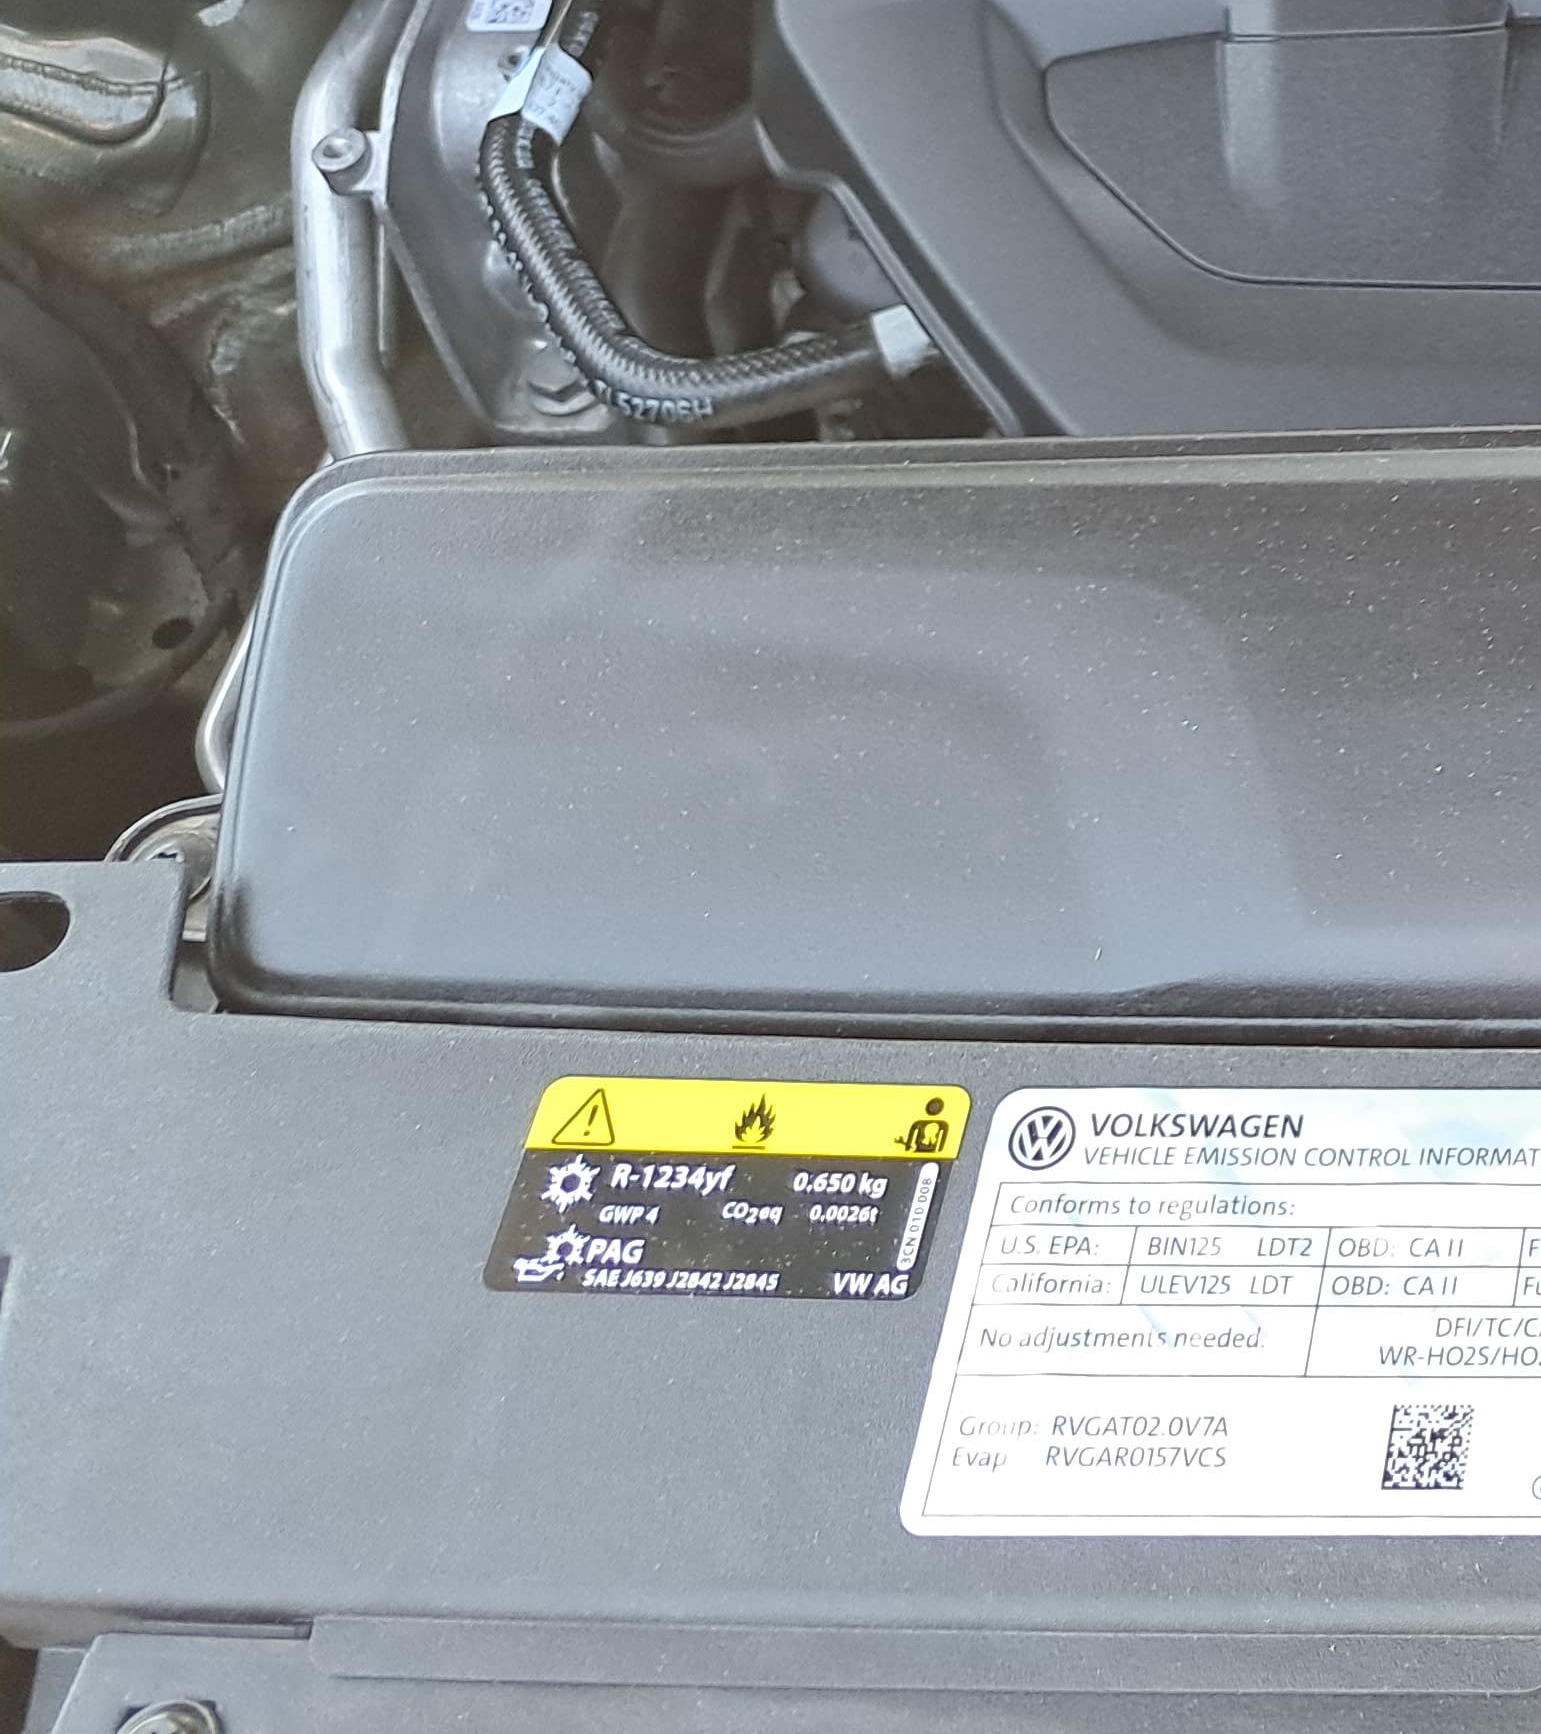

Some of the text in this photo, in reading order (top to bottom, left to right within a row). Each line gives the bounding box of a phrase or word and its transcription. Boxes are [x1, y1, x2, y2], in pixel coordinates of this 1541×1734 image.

[1091, 1113, 1304, 1139] VOLKSWAGEN
[1084, 1147, 1176, 1167] VEHICLE
[1183, 1147, 1297, 1167] EMISSION
[1304, 1147, 1411, 1167] CONTROL
[610, 1165, 736, 1195] R-1234yf
[793, 1174, 888, 1198] 0.650 kg
[599, 1205, 658, 1223] GWP 4
[809, 1206, 878, 1223] 0.0026t
[1010, 1194, 1296, 1221] Conforms to regulations:
[902, 1177, 932, 1266] 3CN 010 008
[586, 1239, 646, 1264] PAG
[1000, 1236, 1100, 1256] U.S. EPA:
[1147, 1237, 1313, 1257] BIN125 LDT2
[1338, 1237, 1440, 1258] OBD: CA
[582, 1270, 780, 1291] SAE J639 J2842 J2845
[833, 1274, 908, 1296] VW AG
[992, 1274, 1111, 1295] California:
[1140, 1275, 1294, 1295] ULEV125 LDT
[1331, 1276, 1435, 1296] OBD: CA
[980, 1327, 1265, 1353] No adjustments needed.
[1051, 1417, 1228, 1437] RVGAT02.0V7A
[1045, 1447, 1227, 1468] RVGAR0157VCS
